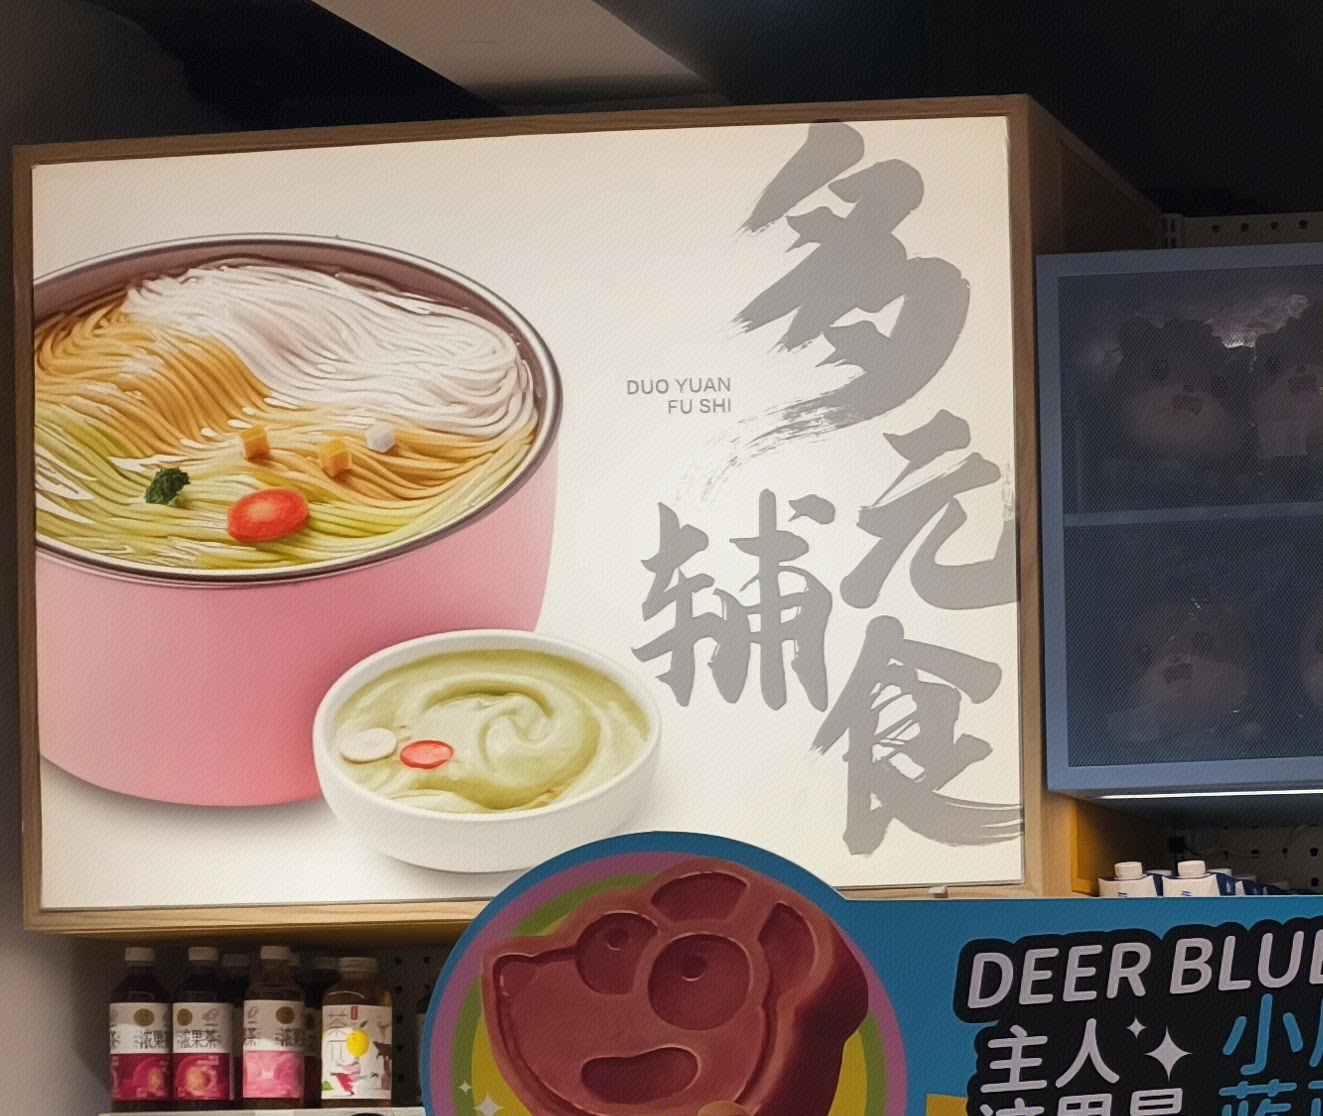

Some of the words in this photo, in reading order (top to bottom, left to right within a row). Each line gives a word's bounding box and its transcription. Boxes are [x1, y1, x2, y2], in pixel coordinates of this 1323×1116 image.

[625, 379, 670, 397] DUO
[674, 376, 731, 395] YUAN
[667, 399, 693, 415] FU
[698, 397, 732, 414] SHI
[966, 940, 1152, 1010] DEER
[981, 1018, 1120, 1094] 主人
